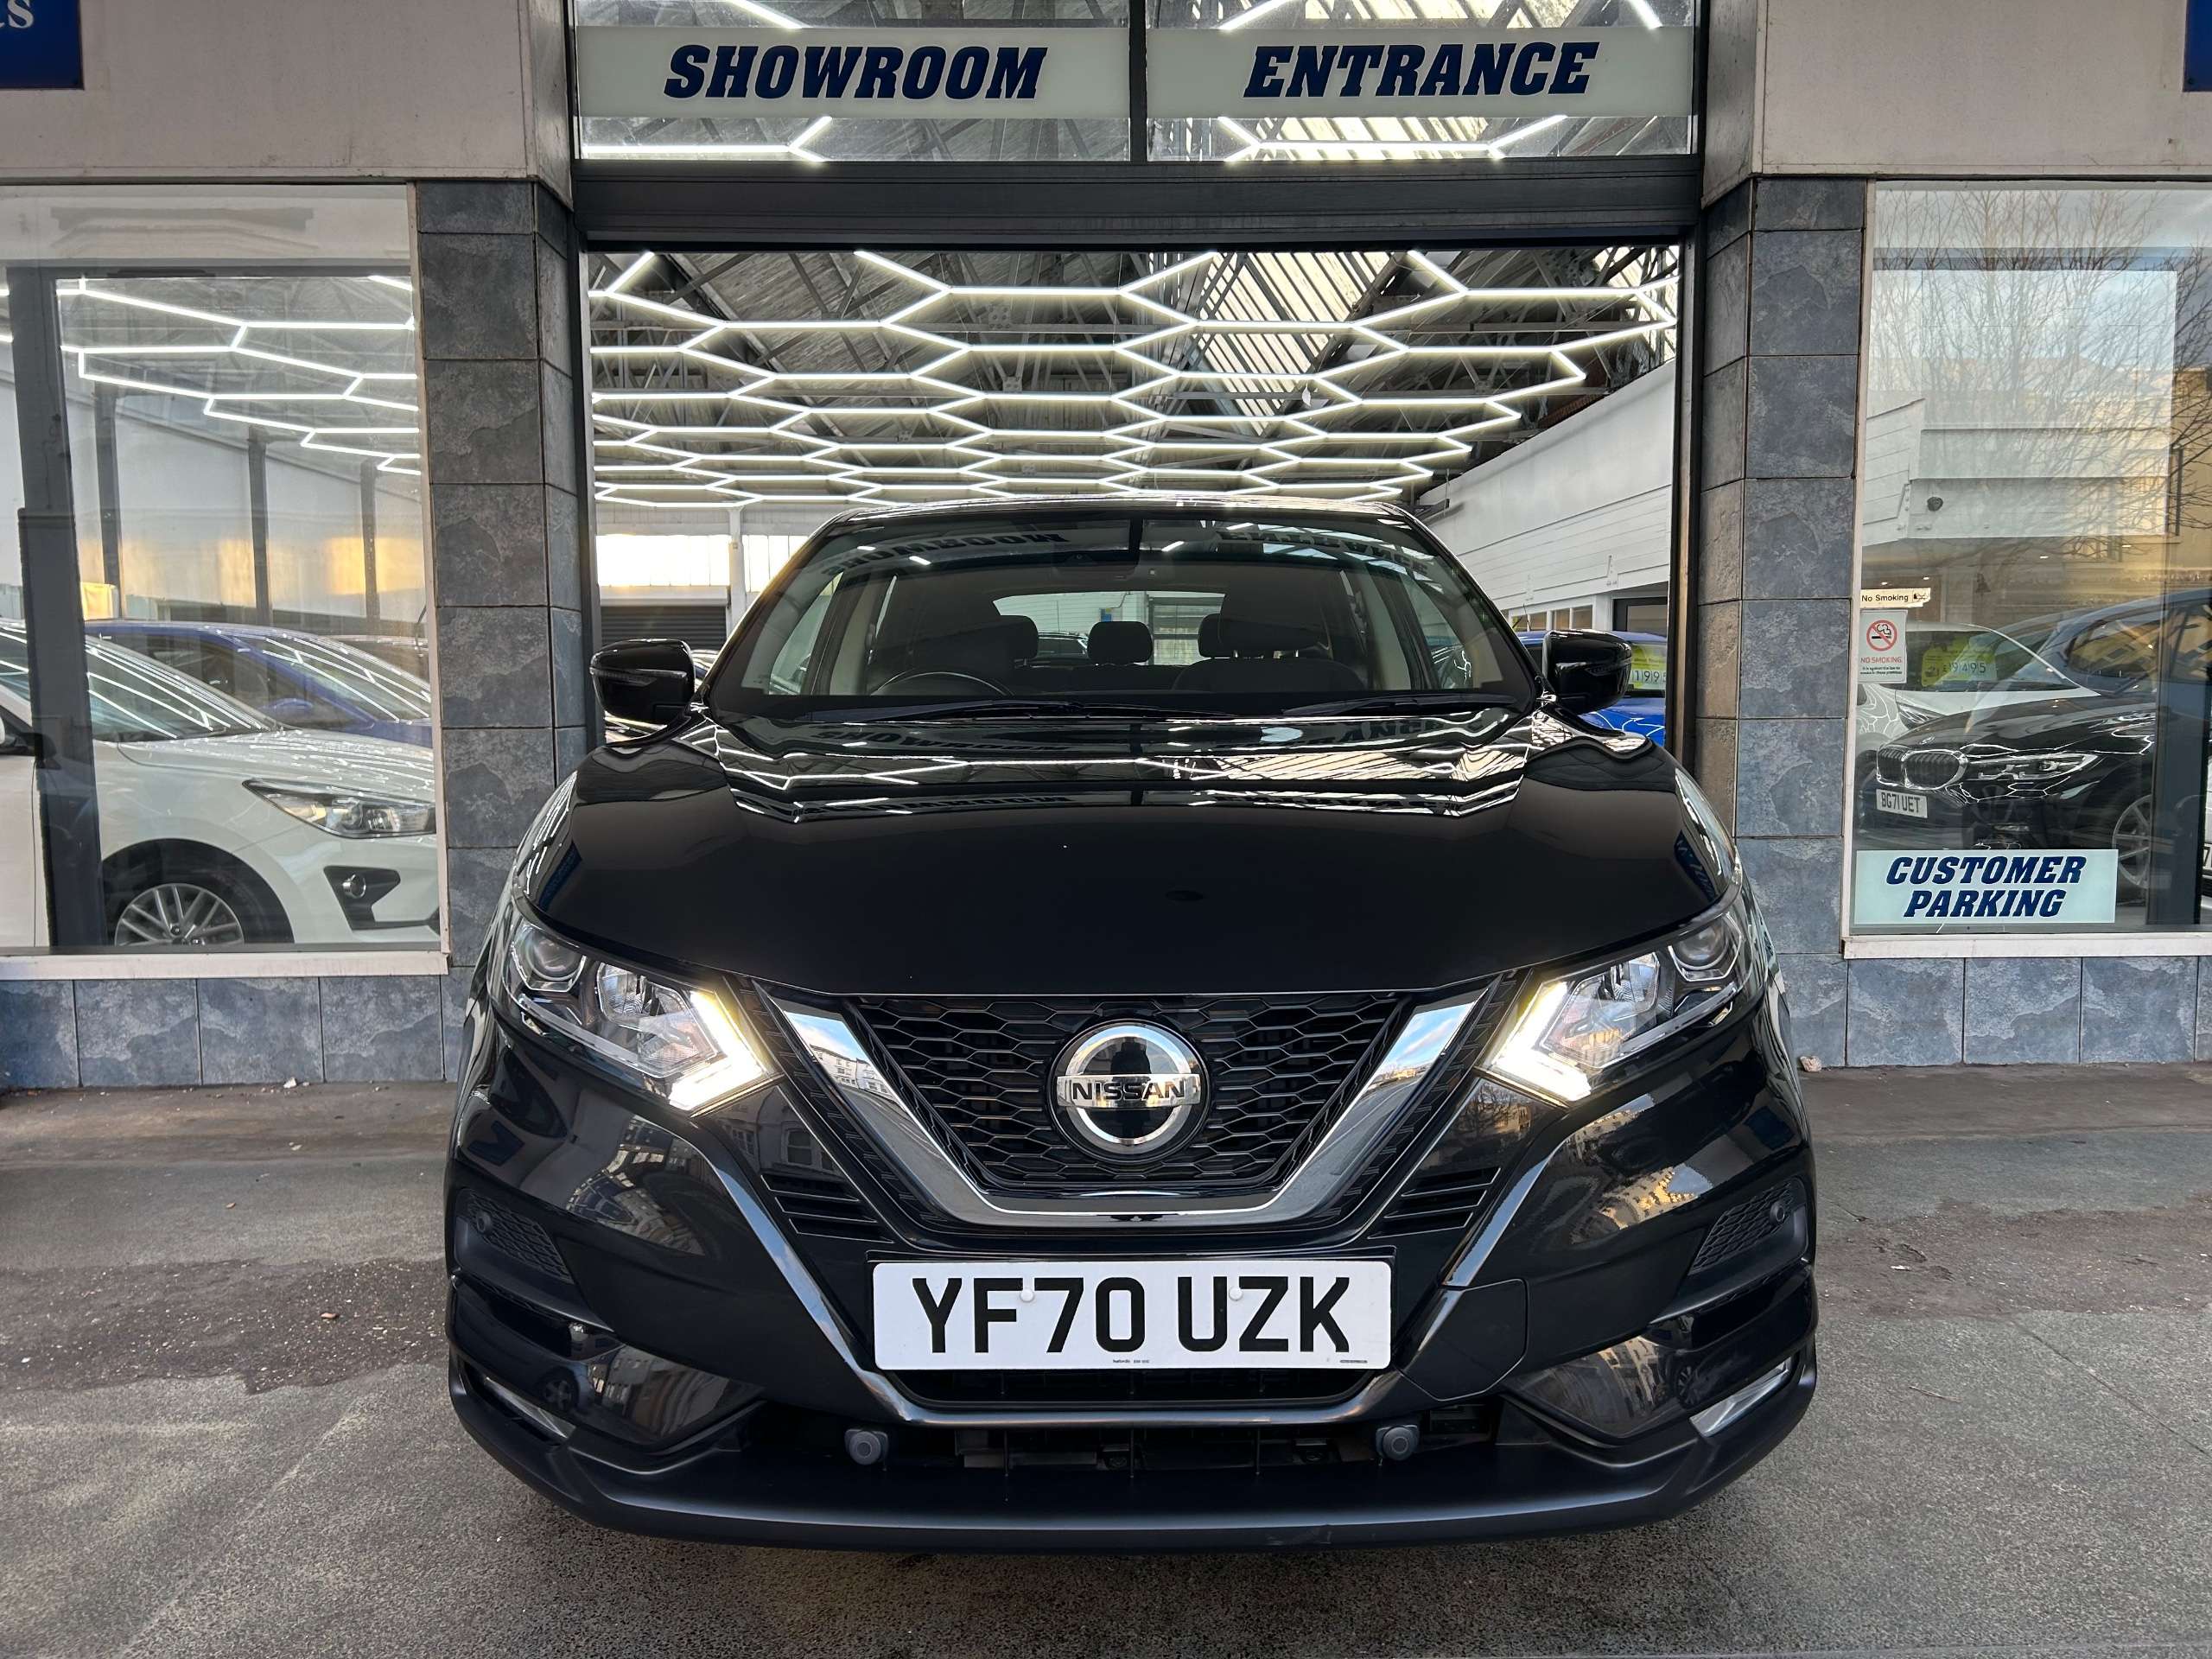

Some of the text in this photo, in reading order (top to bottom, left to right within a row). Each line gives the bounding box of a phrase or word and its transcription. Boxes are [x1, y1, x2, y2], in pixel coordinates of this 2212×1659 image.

[664, 41, 1600, 99] SHOWROOM ENTRANCE
[1875, 594, 1909, 602] Smoking
[1881, 791, 1920, 813] BG71 UET
[1886, 856, 2087, 885] CUSTOMER
[1904, 889, 2067, 918] PARKING
[1072, 1082, 1185, 1101] NISSAN
[912, 1276, 1351, 1354] YF70 UZK
